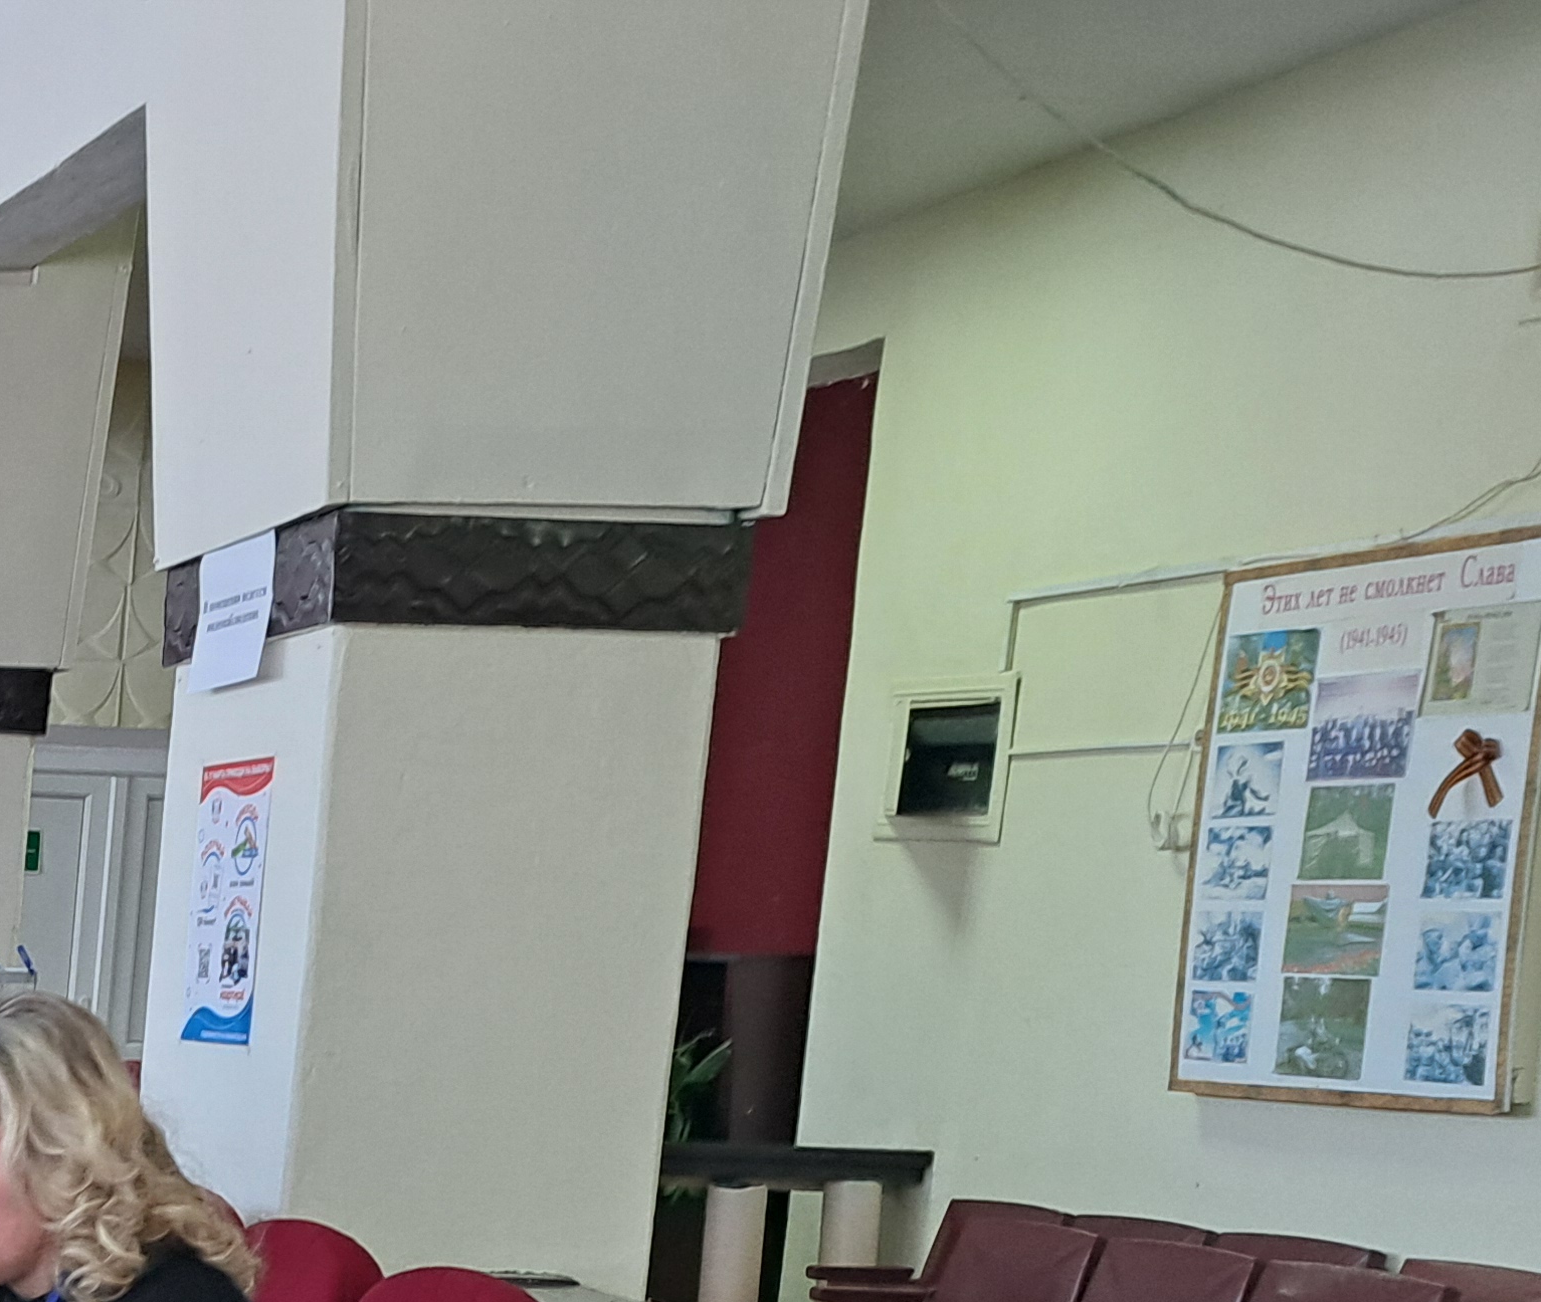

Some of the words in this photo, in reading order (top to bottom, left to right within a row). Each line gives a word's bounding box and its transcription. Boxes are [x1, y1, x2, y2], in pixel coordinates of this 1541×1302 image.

[1261, 583, 1301, 616] Этих
[1305, 588, 1335, 609] лет
[1337, 584, 1359, 606] не
[1363, 571, 1446, 601] смолкнет
[1460, 554, 1517, 590] Слава
